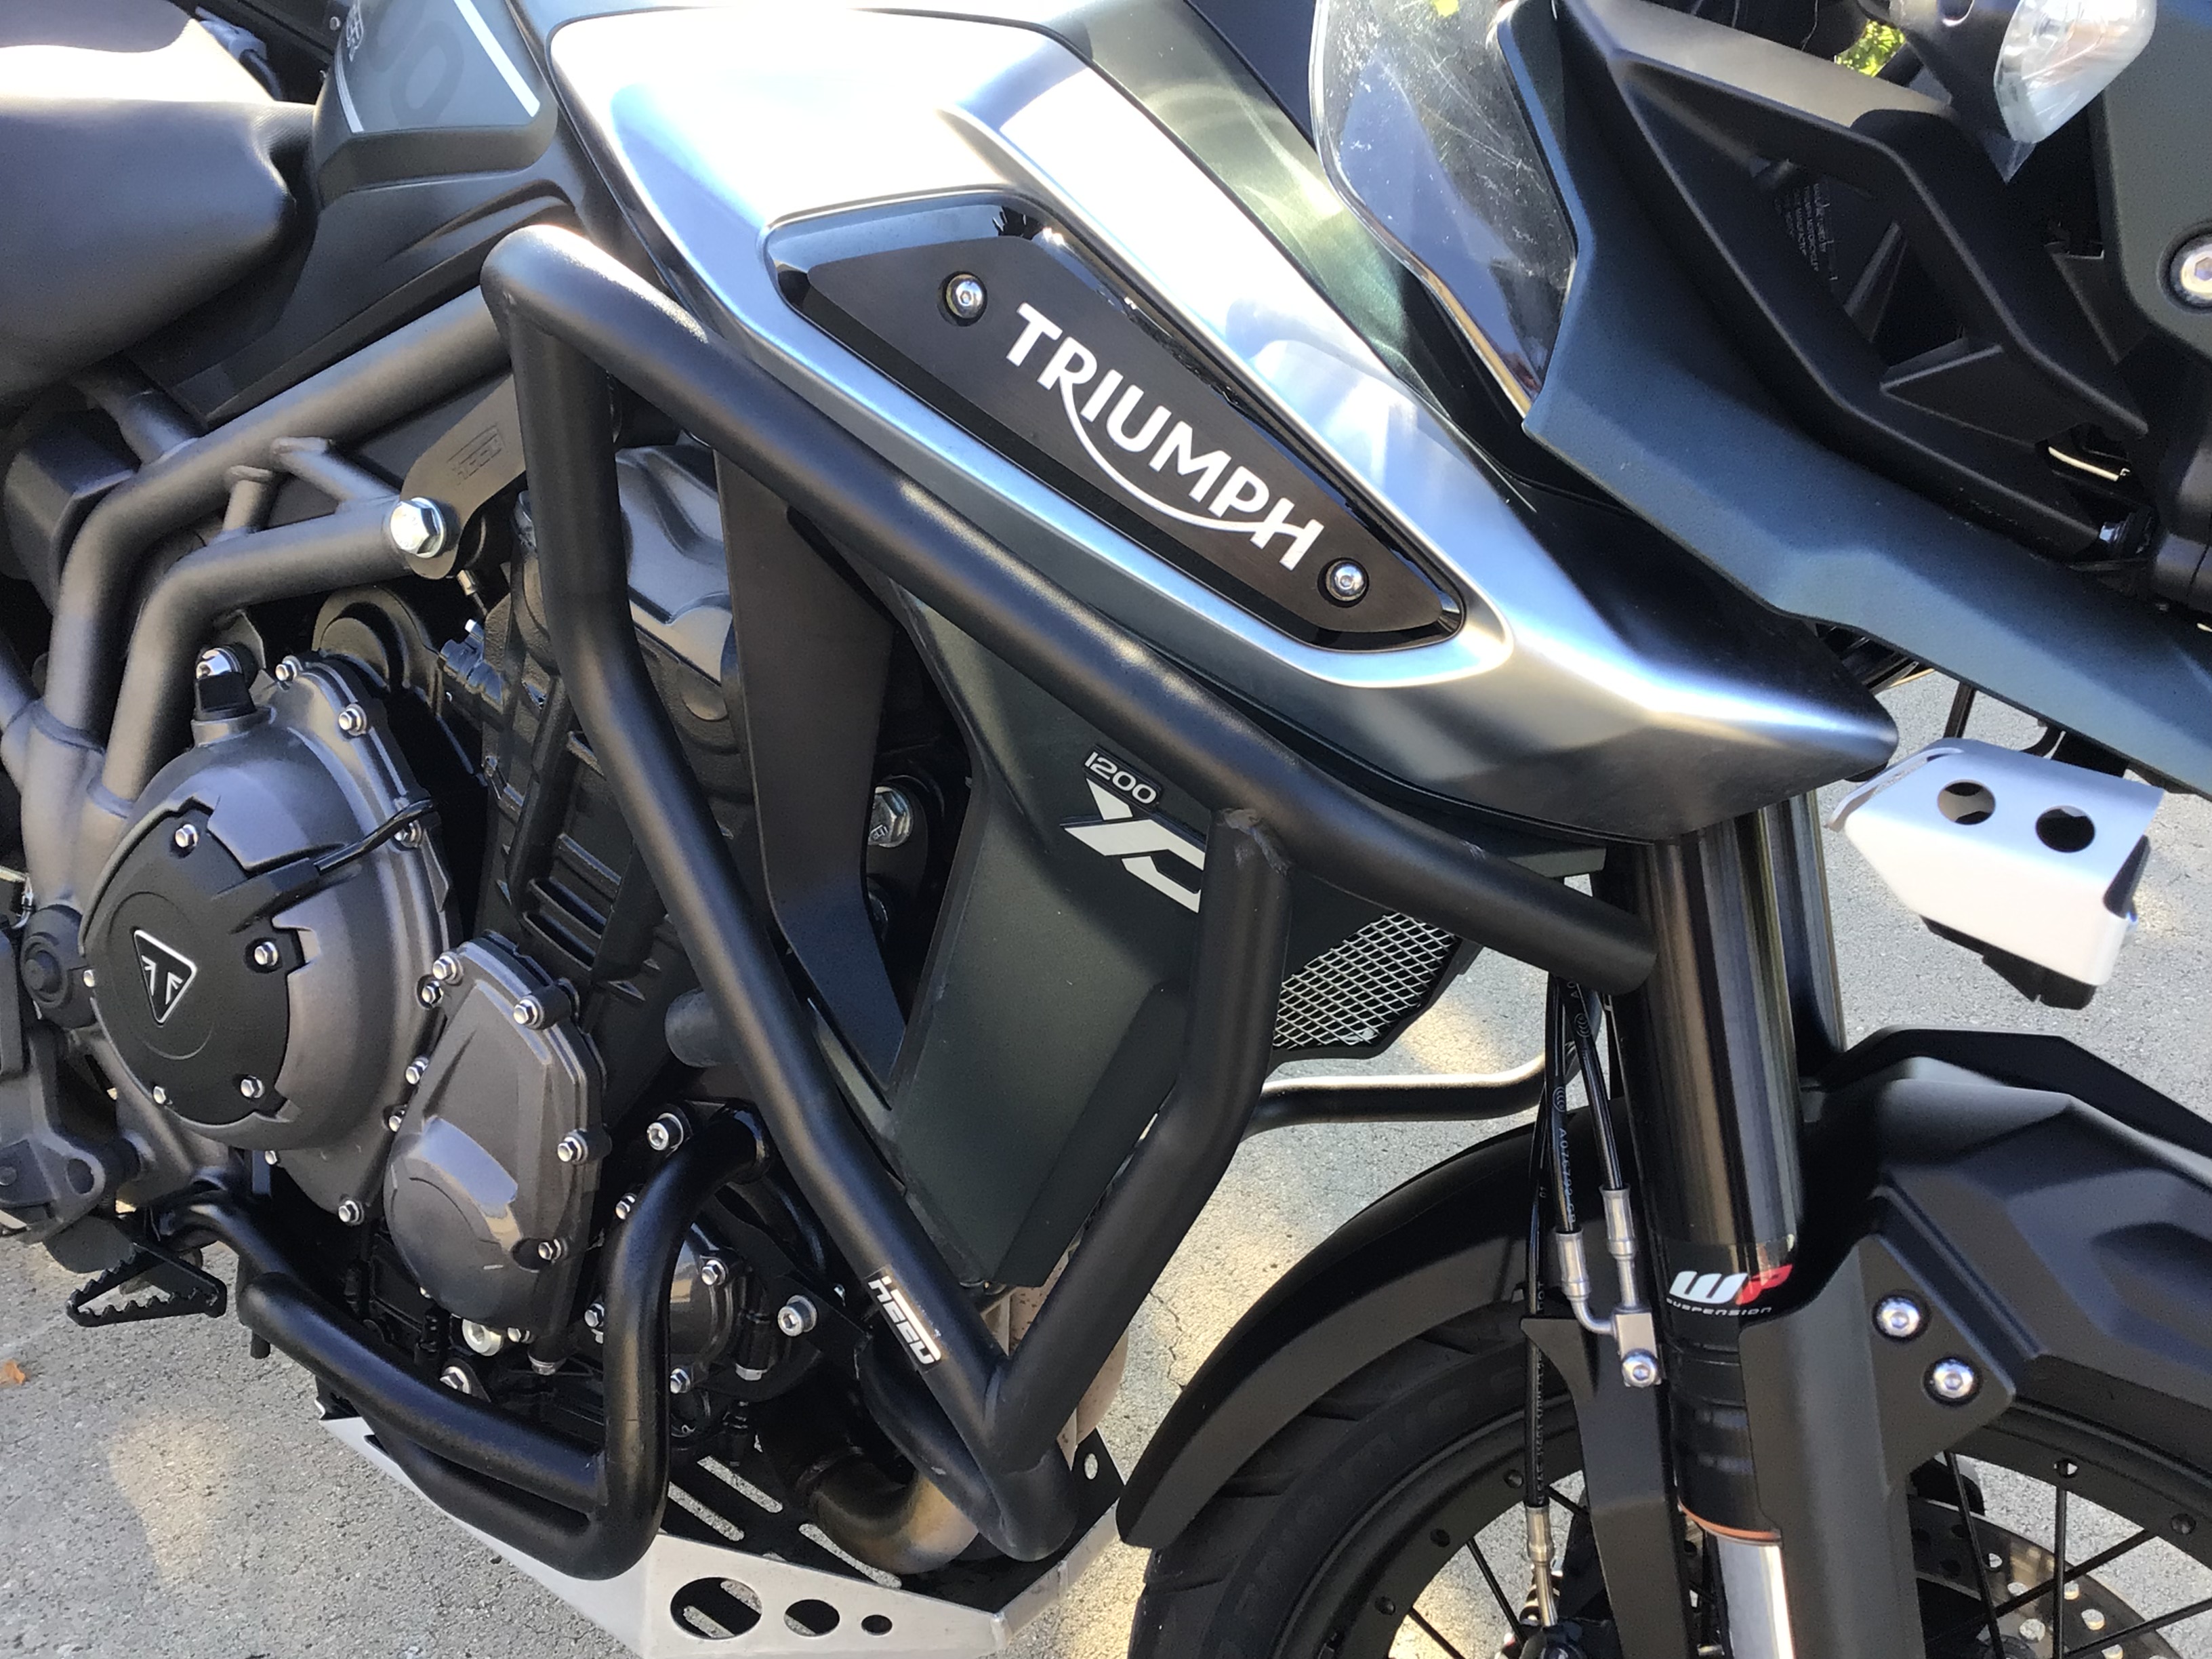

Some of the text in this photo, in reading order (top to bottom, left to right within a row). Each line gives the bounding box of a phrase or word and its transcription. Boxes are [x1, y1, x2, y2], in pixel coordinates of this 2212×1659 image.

[1006, 302, 1325, 571] TRIUMPH
[1084, 751, 1157, 804] 1200
[1666, 1297, 1773, 1317] SUSPENSION
[1669, 1264, 1793, 1305] WP
